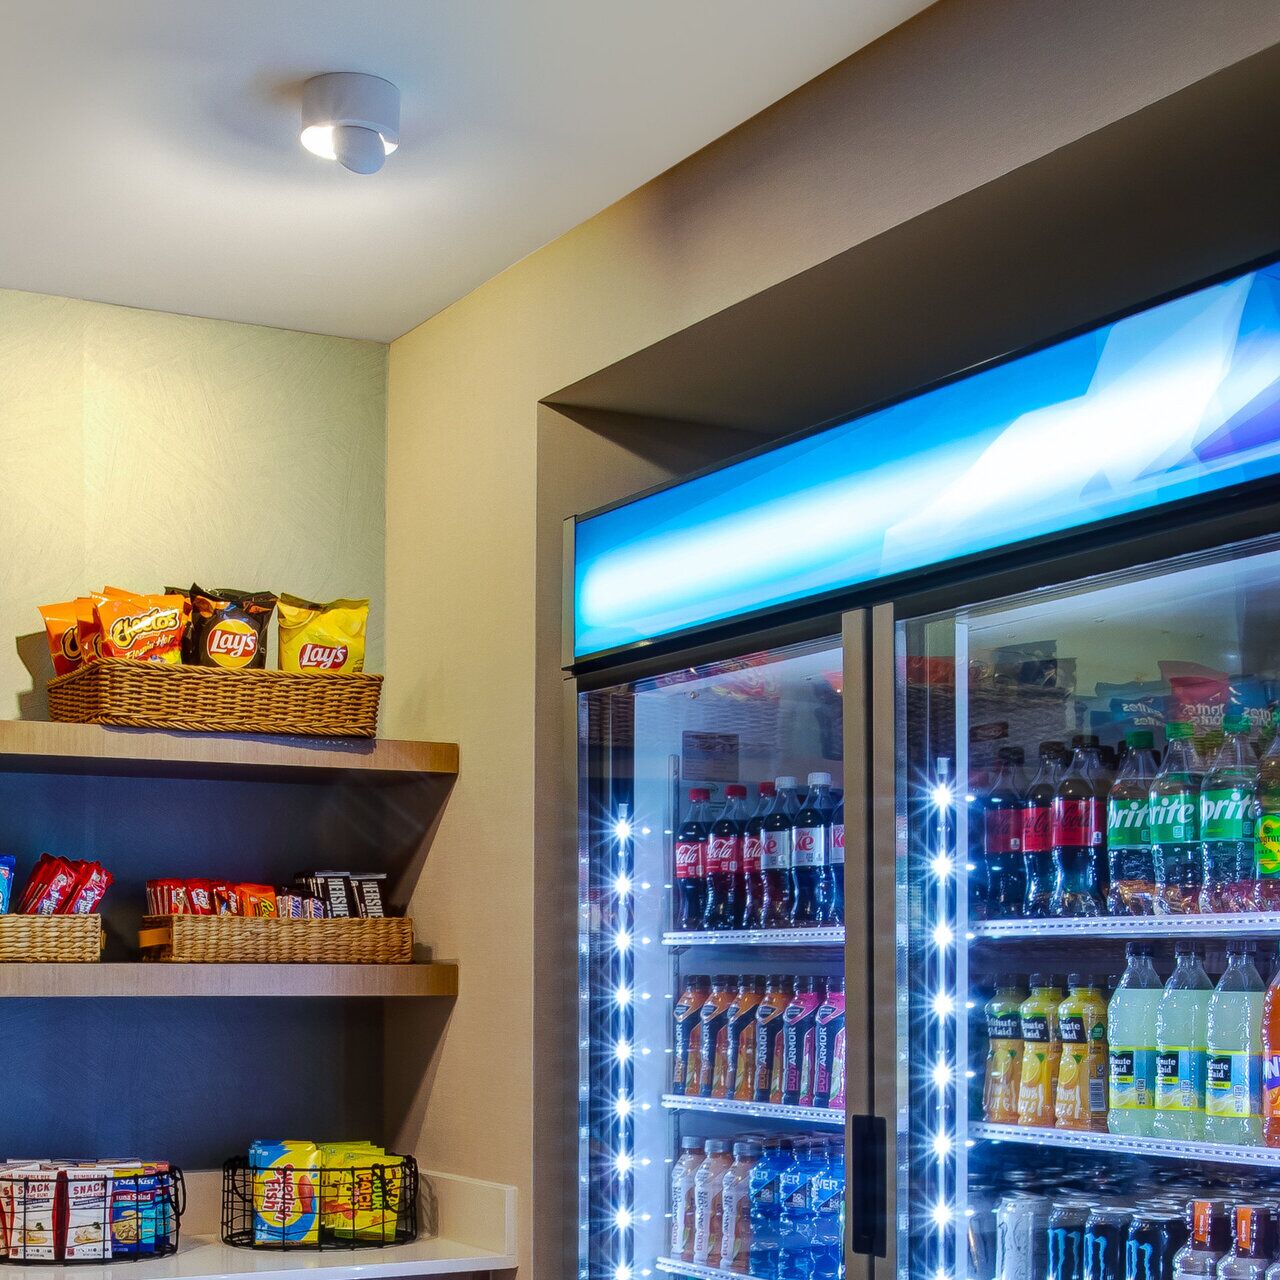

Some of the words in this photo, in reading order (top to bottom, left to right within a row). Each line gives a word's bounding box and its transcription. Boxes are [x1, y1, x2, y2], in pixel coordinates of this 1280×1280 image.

[112, 608, 180, 648] Cheetos
[210, 628, 257, 659] Lay's
[300, 644, 347, 670] Lay's
